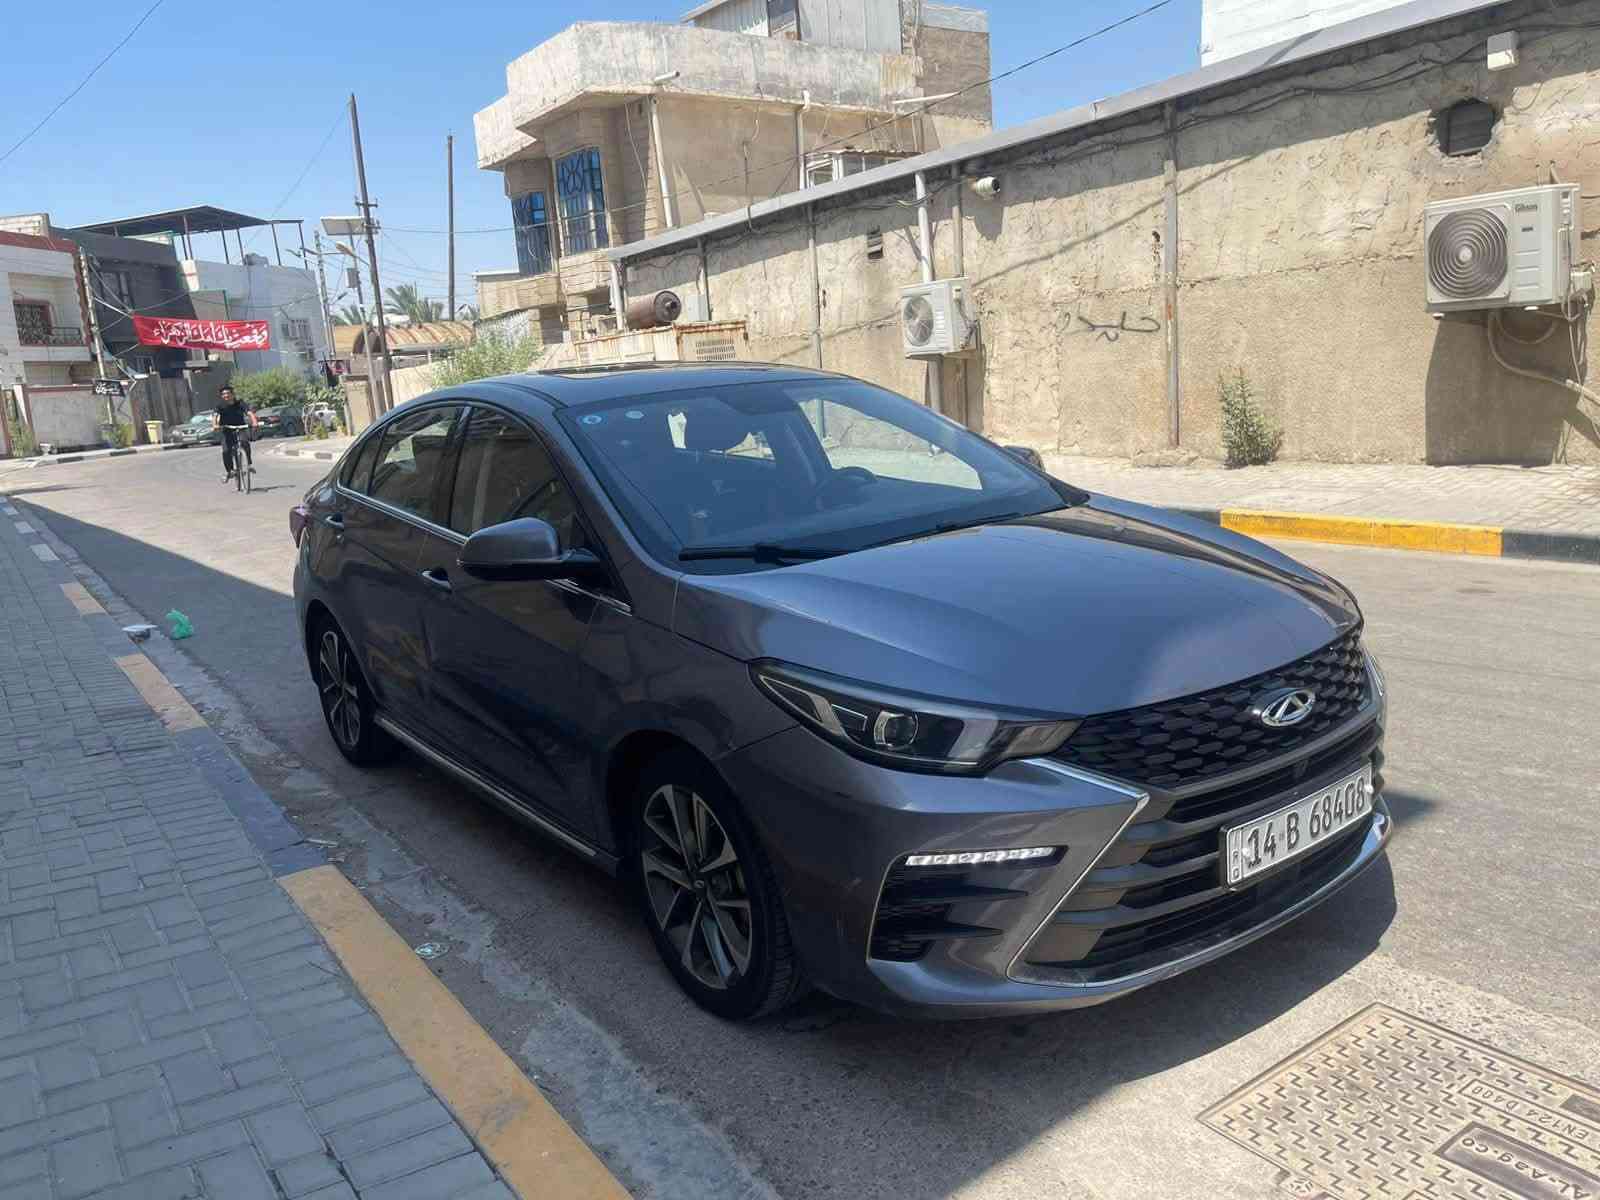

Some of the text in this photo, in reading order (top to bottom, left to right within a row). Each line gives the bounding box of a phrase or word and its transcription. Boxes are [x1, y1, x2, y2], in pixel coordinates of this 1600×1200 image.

[1247, 776, 1365, 868] 14 B 68408
[1471, 1085, 1519, 1110] D400
